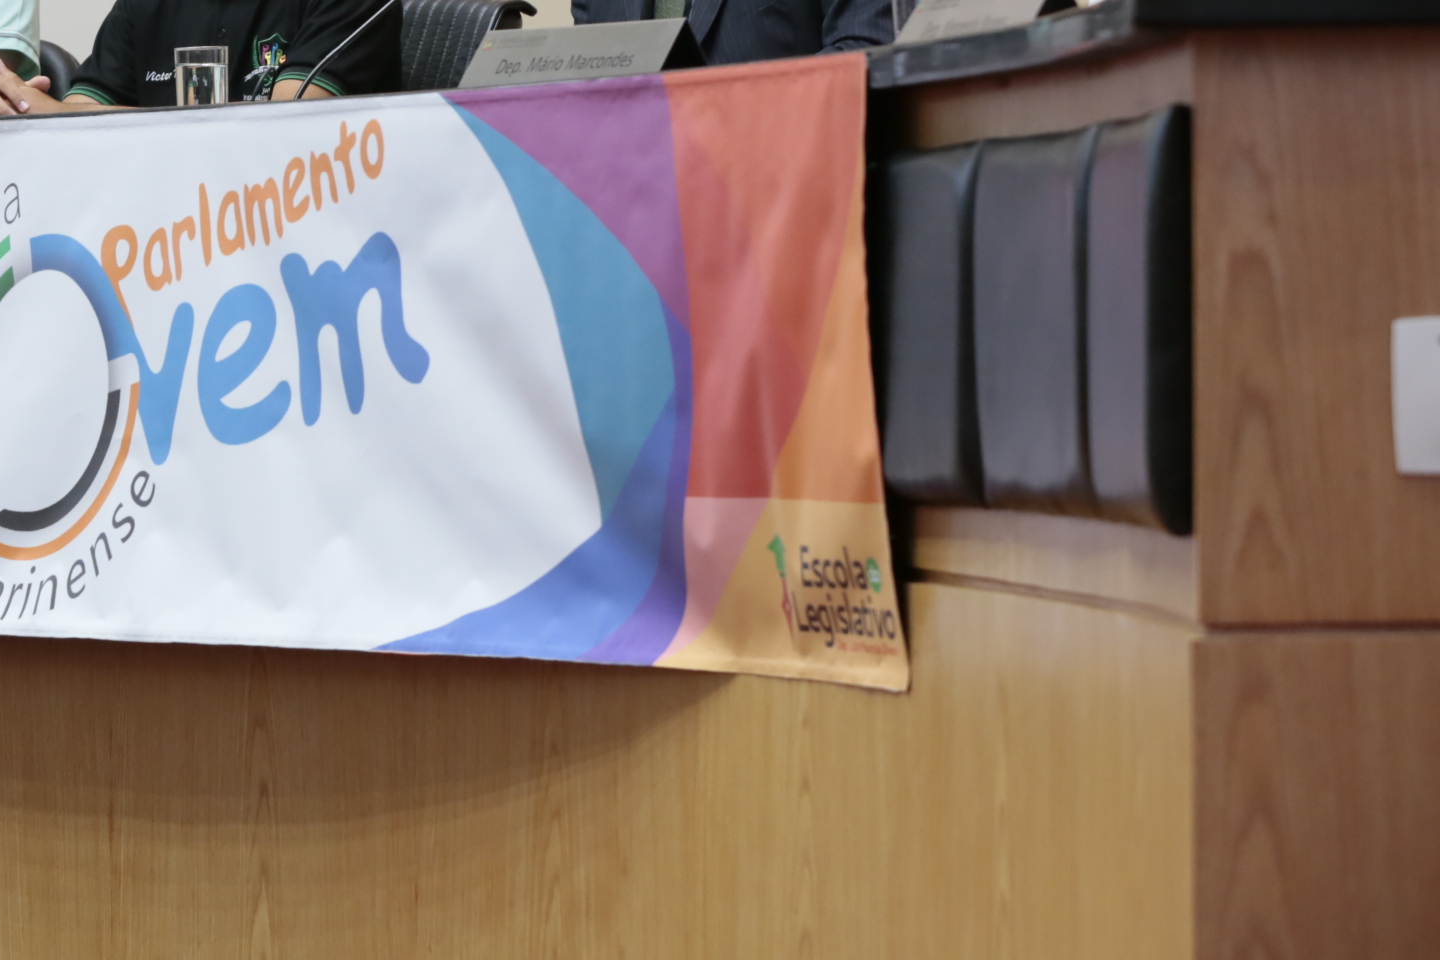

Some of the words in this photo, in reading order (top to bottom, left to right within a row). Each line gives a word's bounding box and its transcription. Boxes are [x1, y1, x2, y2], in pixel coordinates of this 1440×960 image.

[526, 54, 563, 73] Mário
[565, 51, 635, 70] Marcondes
[100, 118, 385, 332] Parlamento
[799, 545, 868, 590] Escola
[791, 591, 896, 648] Legislativo
